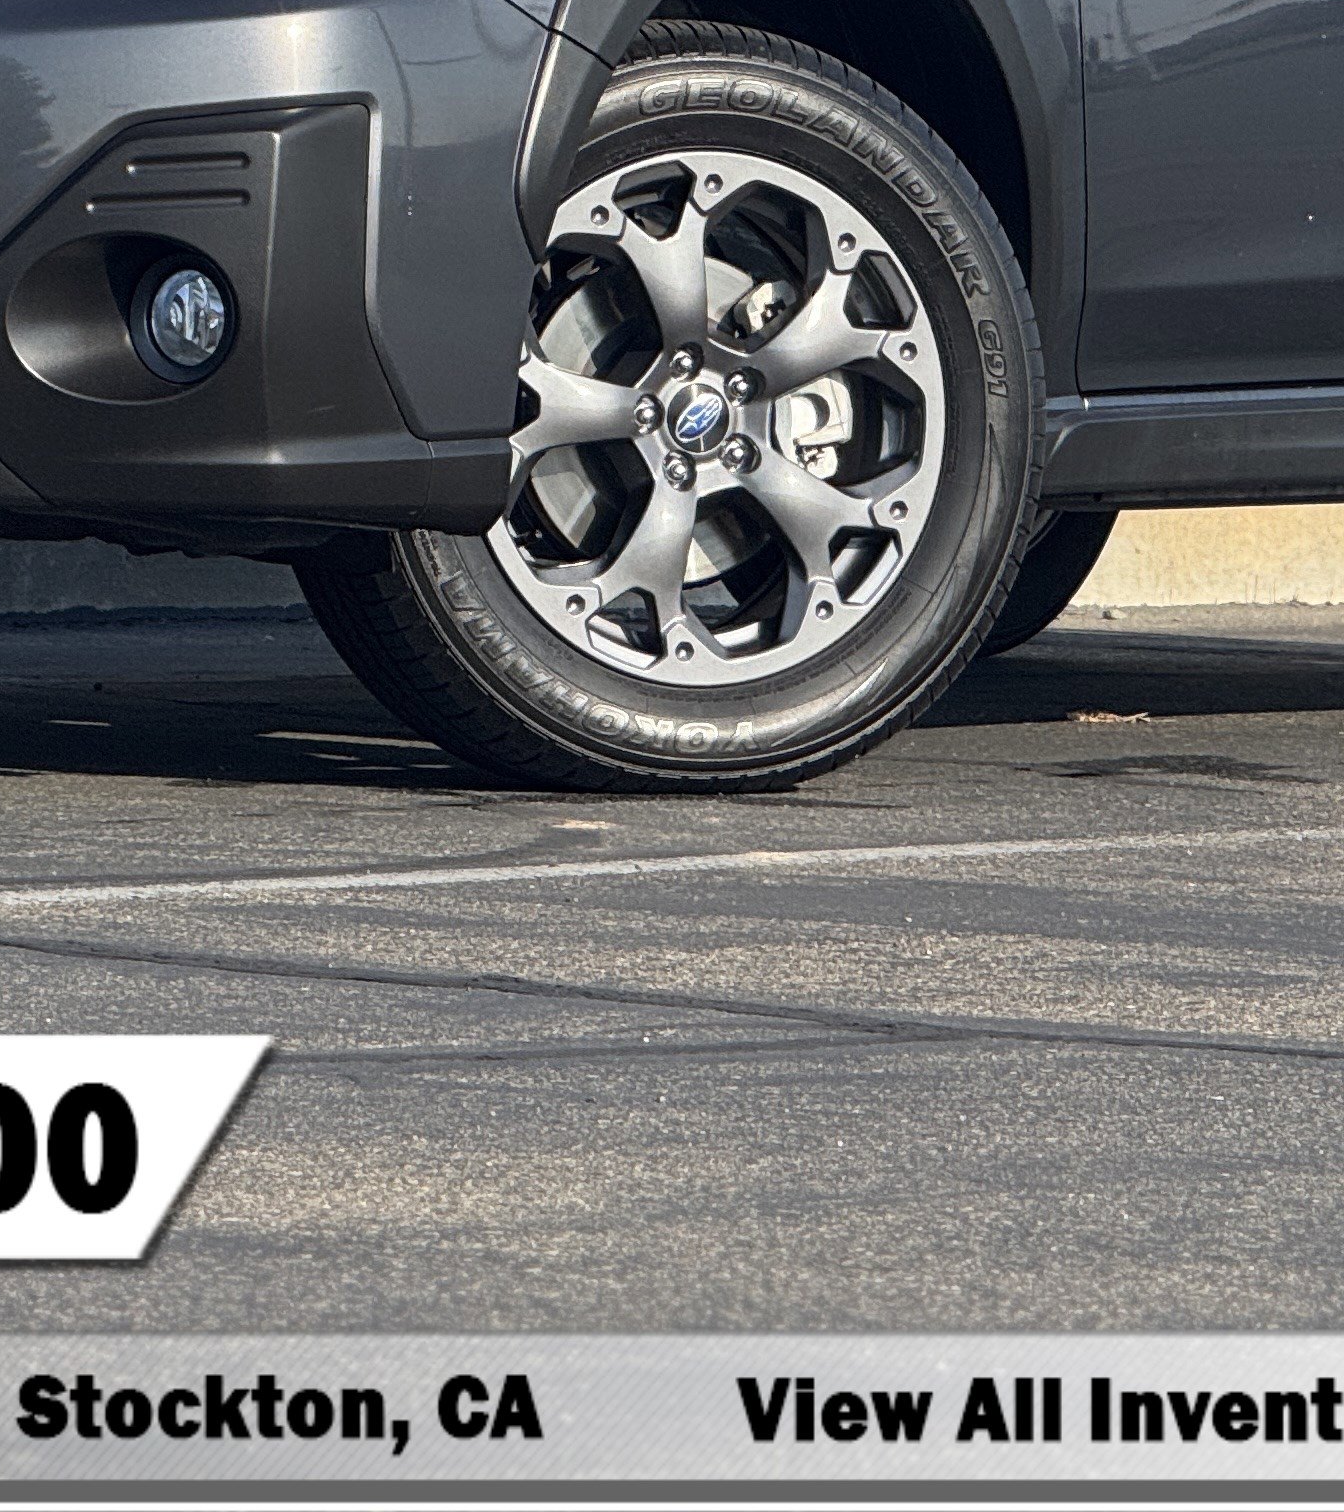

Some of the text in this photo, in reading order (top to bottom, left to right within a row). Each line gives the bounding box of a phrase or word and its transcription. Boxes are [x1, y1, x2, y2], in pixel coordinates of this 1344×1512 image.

[639, 78, 990, 299] GEOLANDAR
[977, 318, 1010, 397] G91
[441, 571, 767, 753] YOKOHAMA
